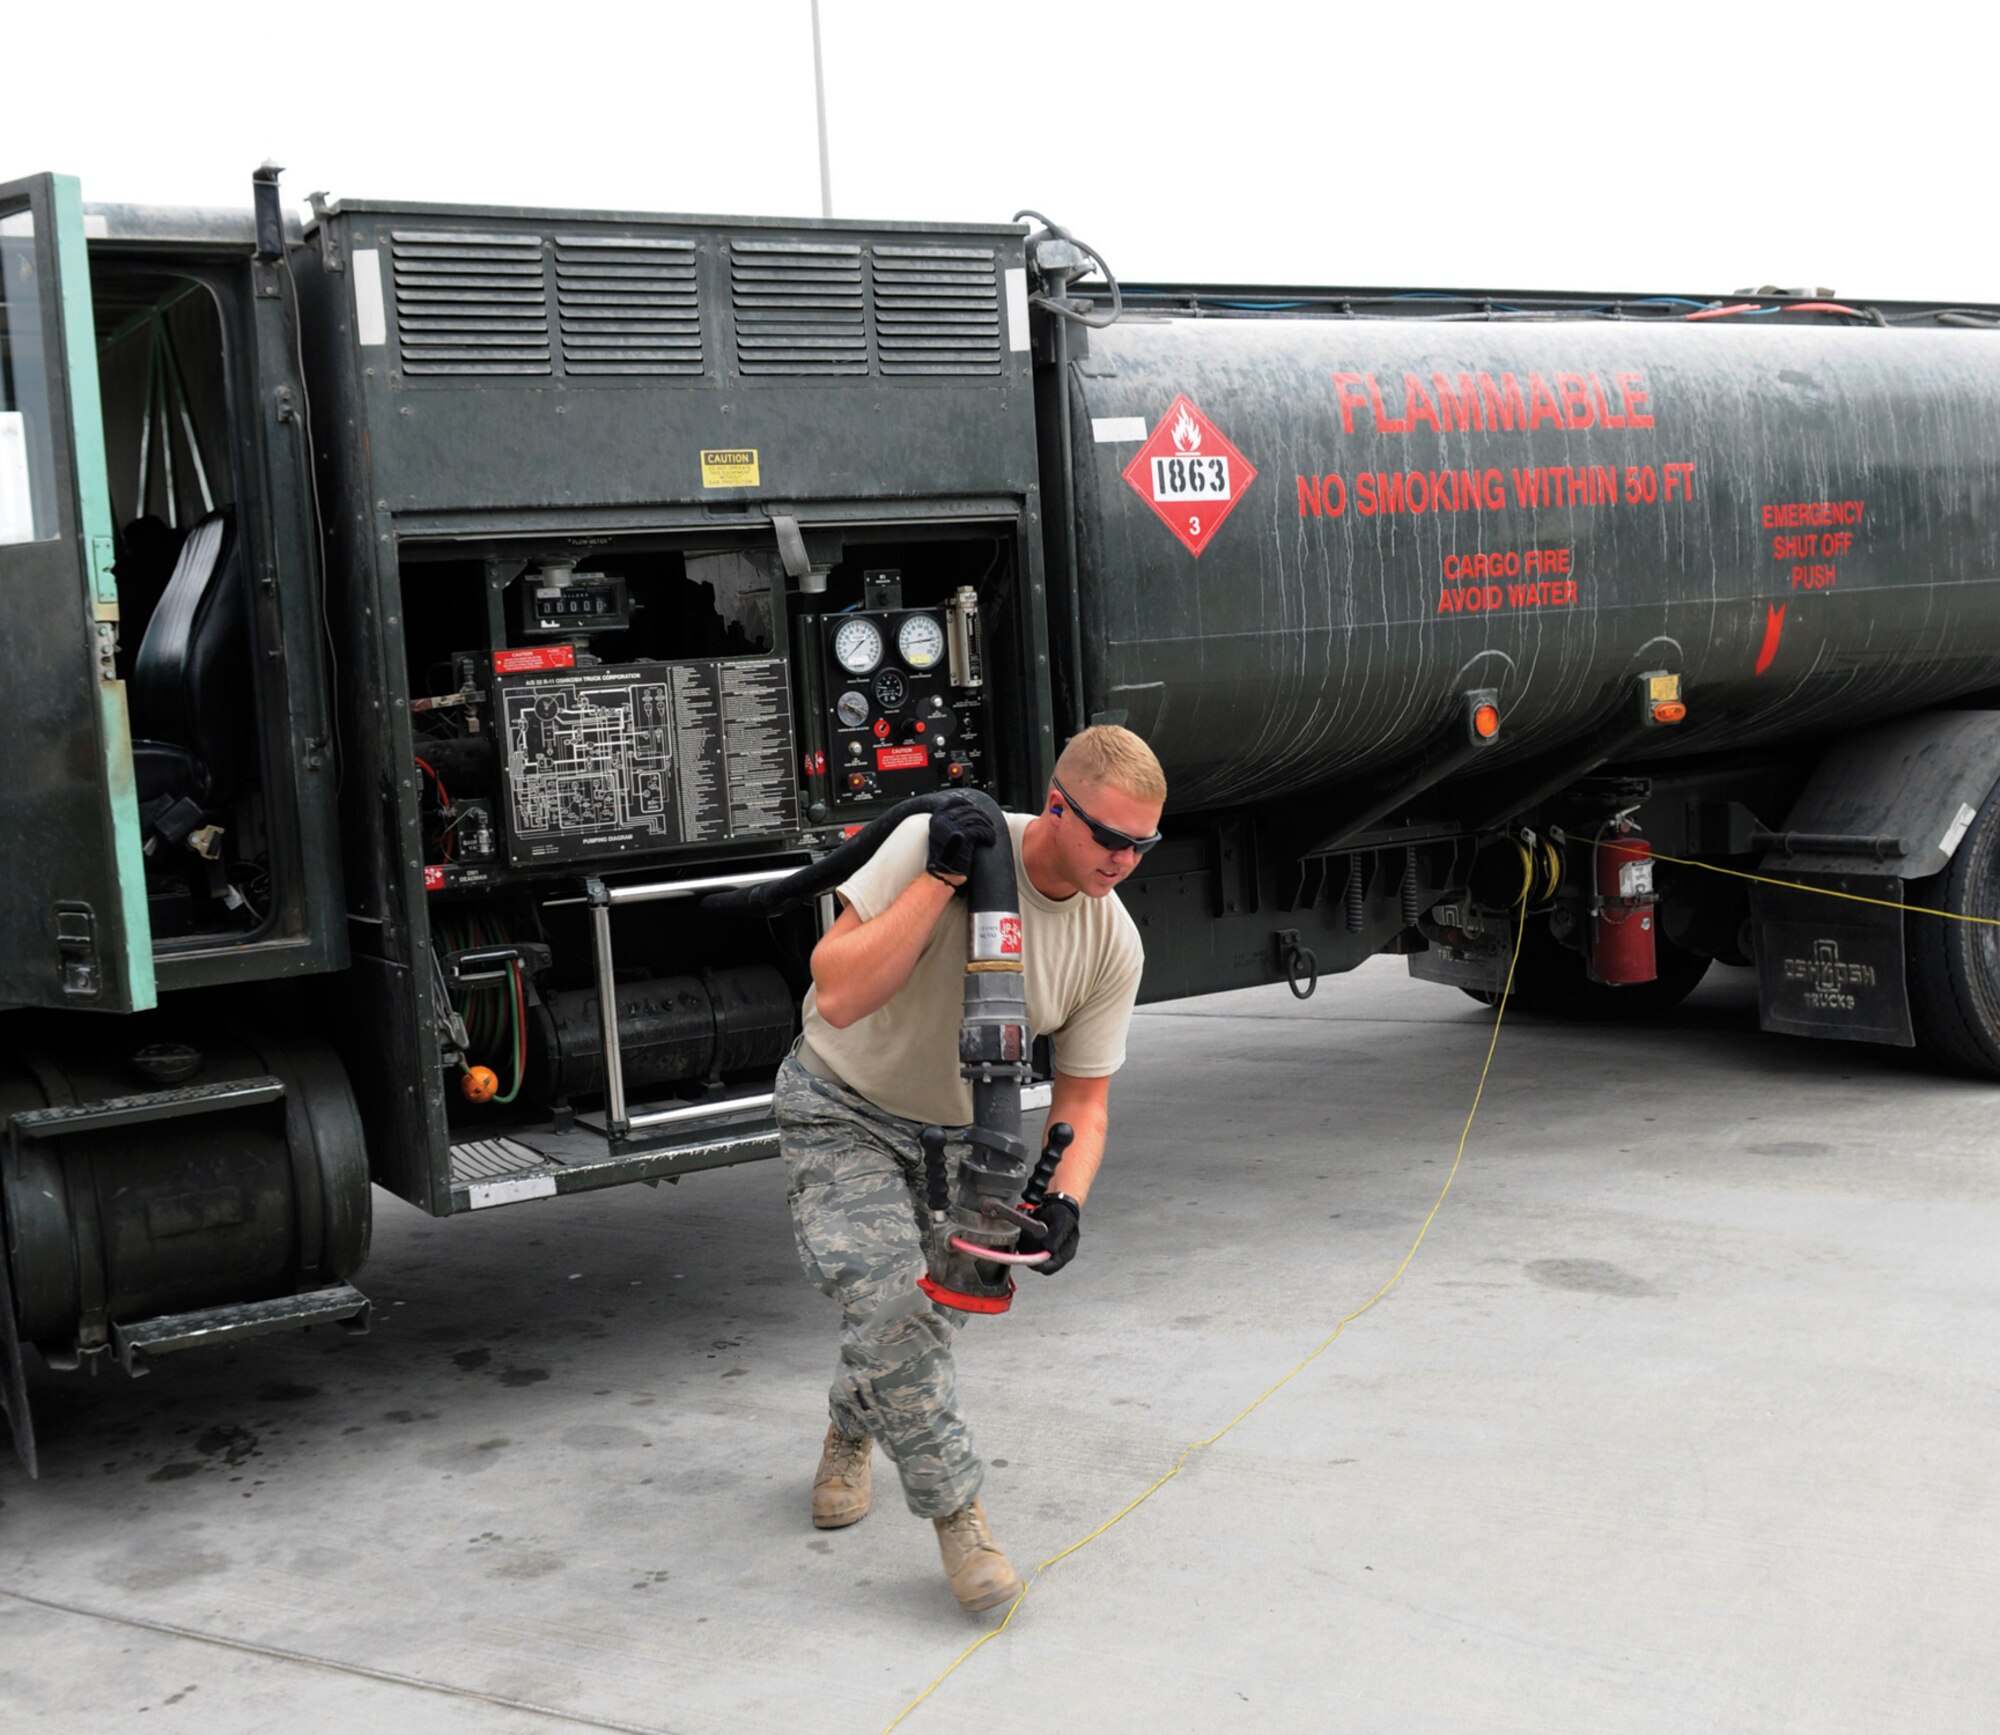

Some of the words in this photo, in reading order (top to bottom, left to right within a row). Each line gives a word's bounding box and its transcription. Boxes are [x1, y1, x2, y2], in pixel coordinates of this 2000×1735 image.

[1332, 372, 1655, 434] FLAMMABLE
[707, 453, 749, 464] CAUTION
[1157, 458, 1226, 495] 1863
[1297, 473, 1347, 518] NO
[1355, 468, 1507, 517] SMOKING
[1511, 465, 1619, 509] WITHIN
[1625, 465, 1657, 505] 50
[1662, 463, 1696, 502] FT
[1188, 515, 1201, 536] 3
[1762, 500, 1865, 529] EMERGENCY
[1772, 534, 1819, 560] SHUT
[1820, 532, 1853, 558] OFF
[1443, 551, 1521, 581] CARGO
[1525, 548, 1571, 575] FIRE
[1792, 564, 1837, 592] PUSH
[1437, 585, 1503, 614] AVOID
[1507, 580, 1578, 609] WATER
[602, 672, 641, 680] CORPORATION
[583, 836, 607, 845] PUMPING
[608, 834, 633, 842] DIAGRAM
[1804, 992, 1855, 1010] TRUCKS
